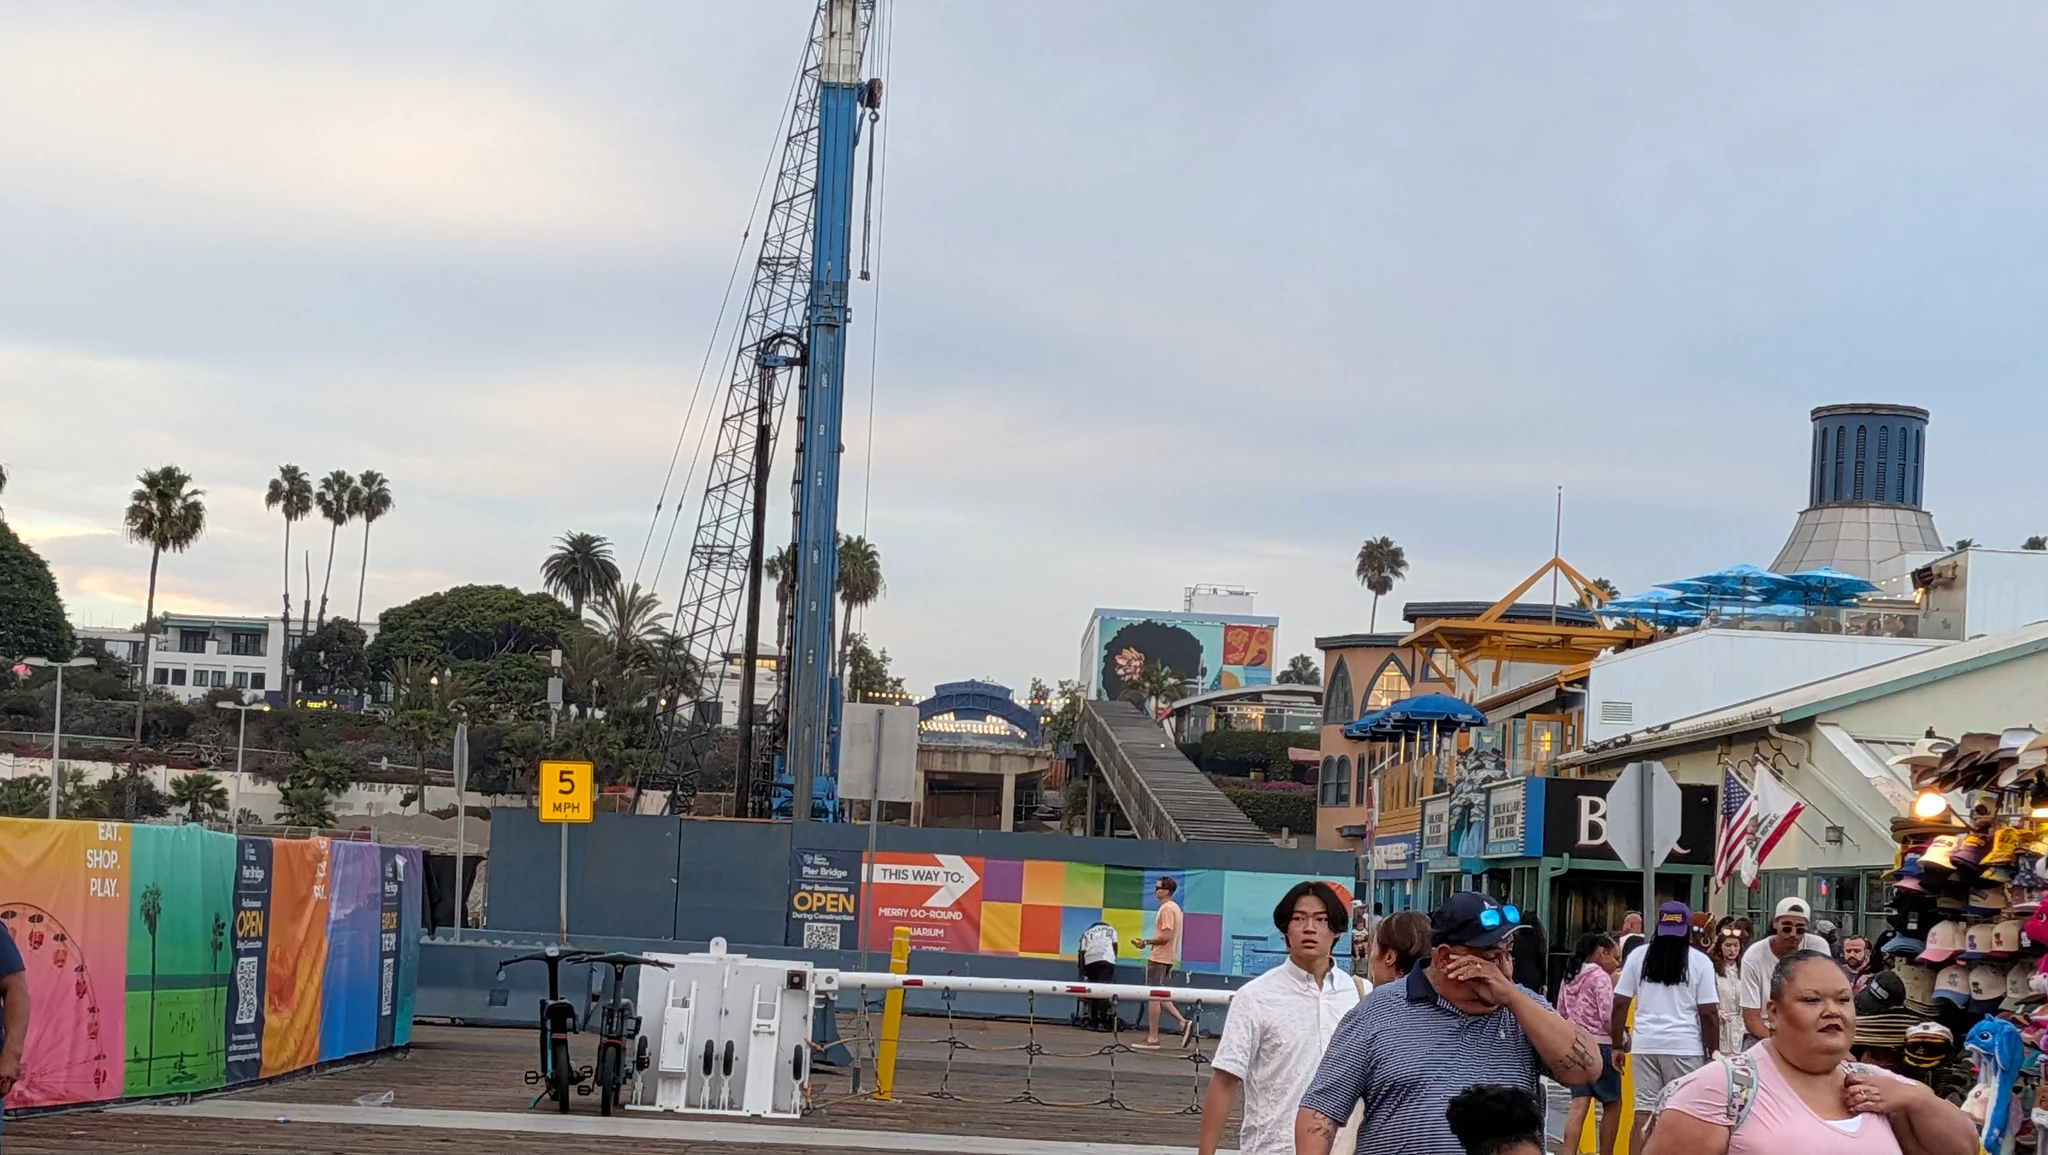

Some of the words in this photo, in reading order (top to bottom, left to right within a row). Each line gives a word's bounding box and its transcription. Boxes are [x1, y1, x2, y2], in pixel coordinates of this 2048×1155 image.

[558, 770, 575, 795] 5
[553, 802, 580, 813] MPH
[98, 822, 122, 841] EAT.
[86, 848, 120, 869] SHOP.
[803, 866, 819, 875] Pier
[820, 867, 848, 878] Bridge
[881, 868, 909, 880] THIS
[912, 870, 940, 882] WAY
[943, 871, 964, 883] TO:
[90, 877, 120, 897] PLAY.
[793, 891, 855, 913] OPEN
[792, 912, 813, 920] During
[878, 907, 909, 917] MERRY
[910, 908, 963, 920] GO-ROUND
[236, 910, 264, 938] OPEN
[909, 927, 944, 938] UARIUM
